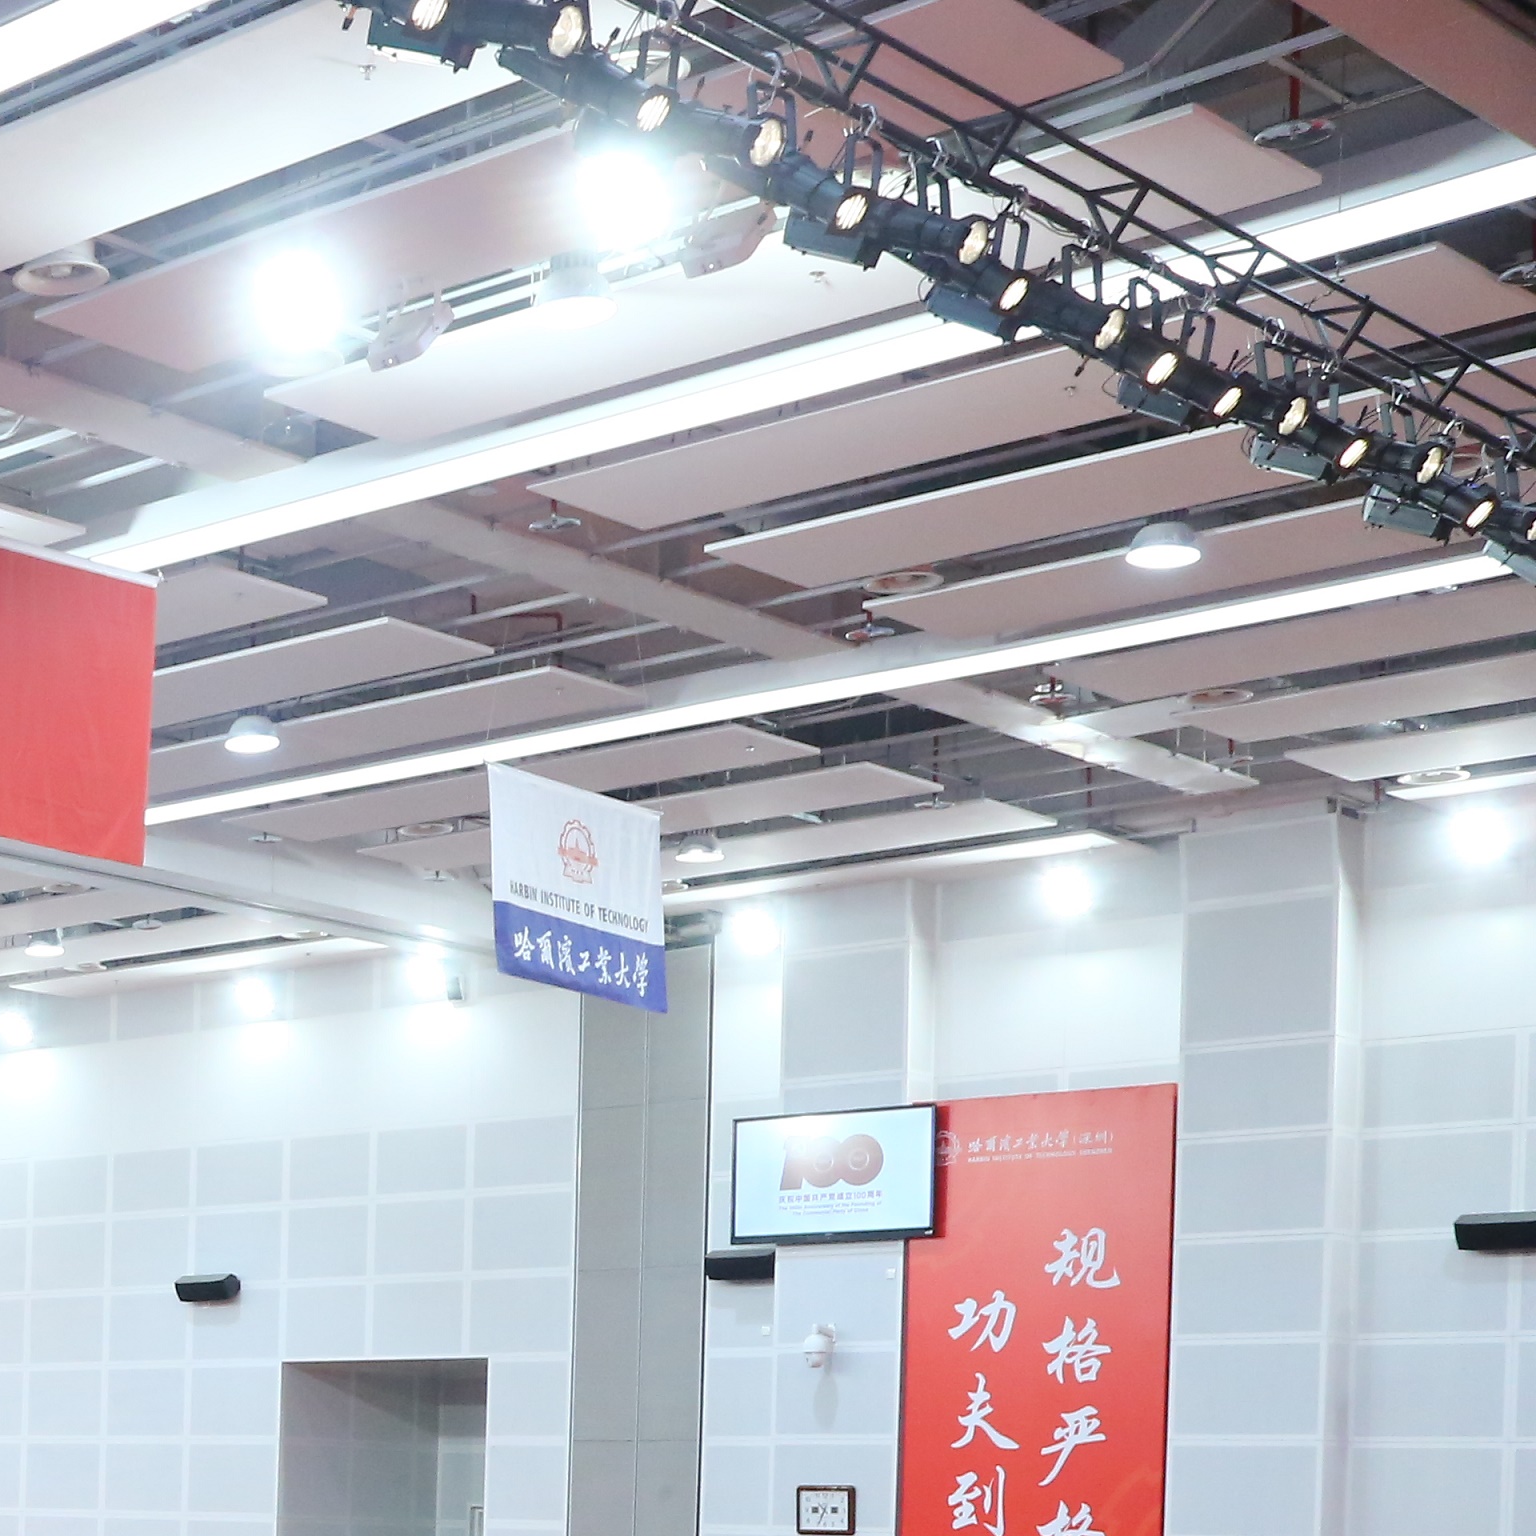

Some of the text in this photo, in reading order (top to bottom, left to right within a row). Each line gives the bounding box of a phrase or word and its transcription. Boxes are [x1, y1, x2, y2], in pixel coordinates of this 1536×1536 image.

[509, 879, 649, 934] HARBIN INSTITUTE OF TECHNOLOGY
